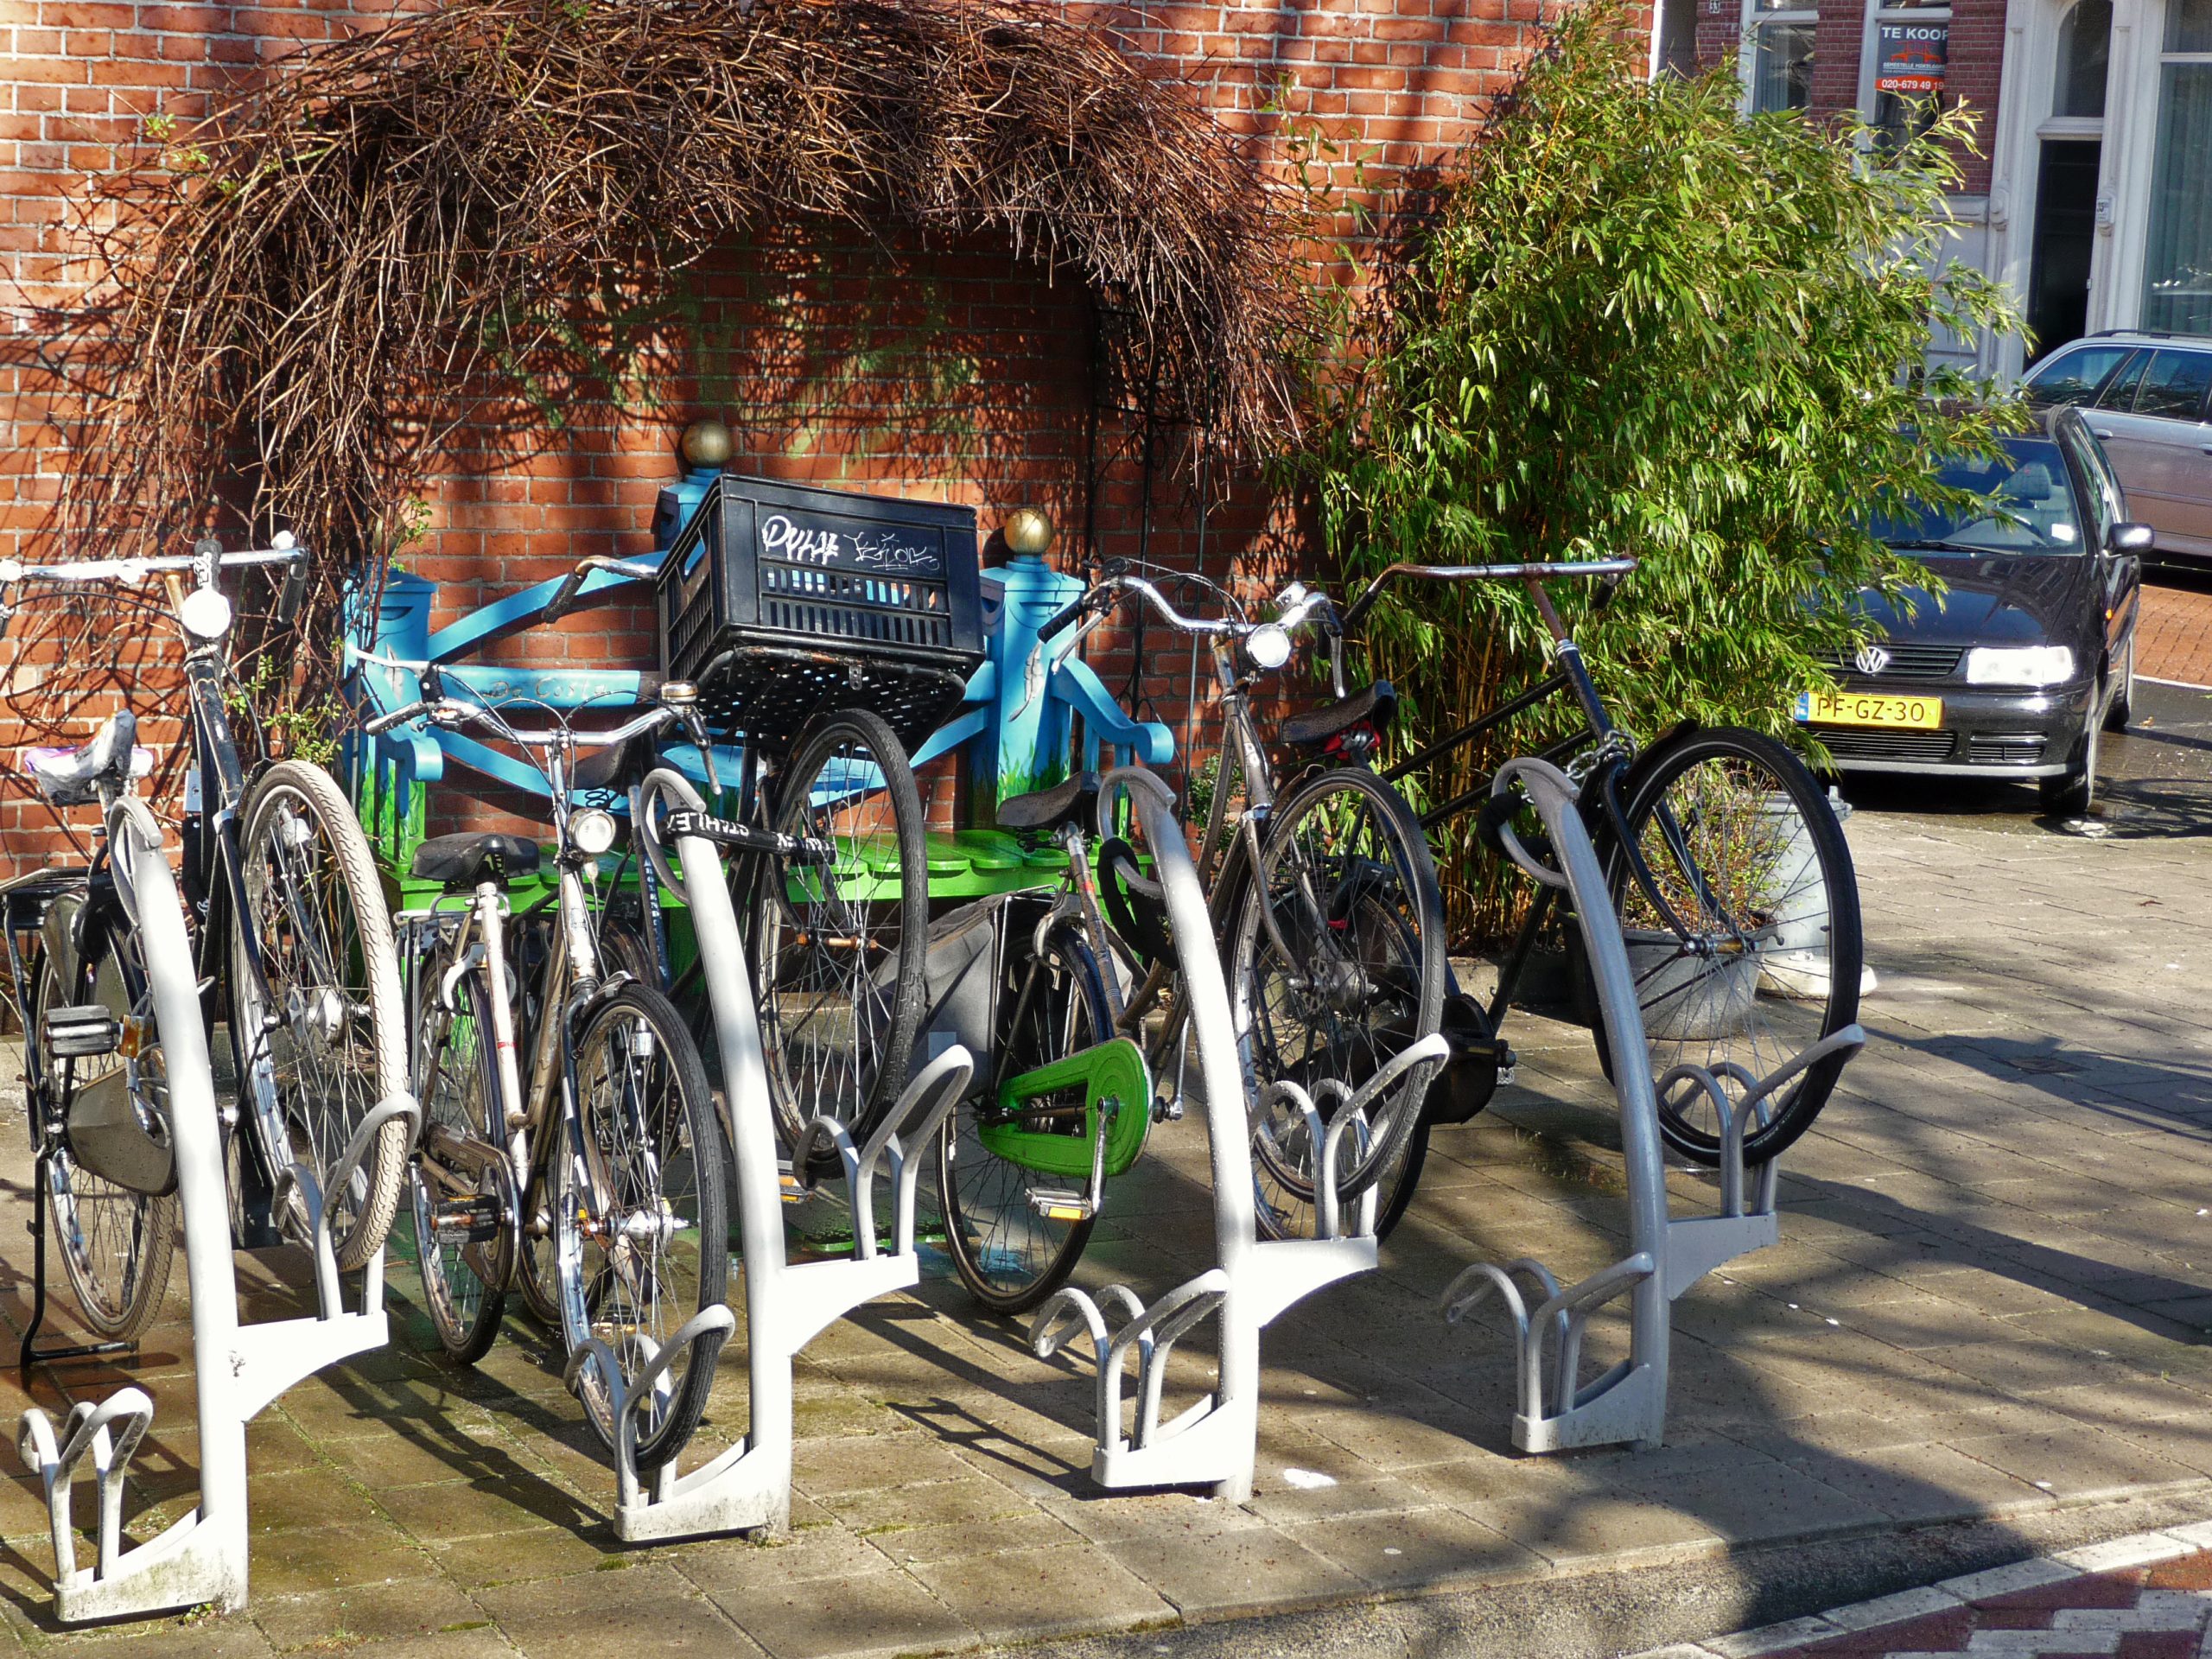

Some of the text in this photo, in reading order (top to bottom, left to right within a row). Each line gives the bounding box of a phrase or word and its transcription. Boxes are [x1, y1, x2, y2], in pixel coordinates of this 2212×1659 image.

[1882, 27, 1901, 39] TE
[1881, 79, 1944, 90] 020-679 49 19
[536, 677, 607, 699] Costa
[1817, 697, 1924, 721] PF-GZ-30
